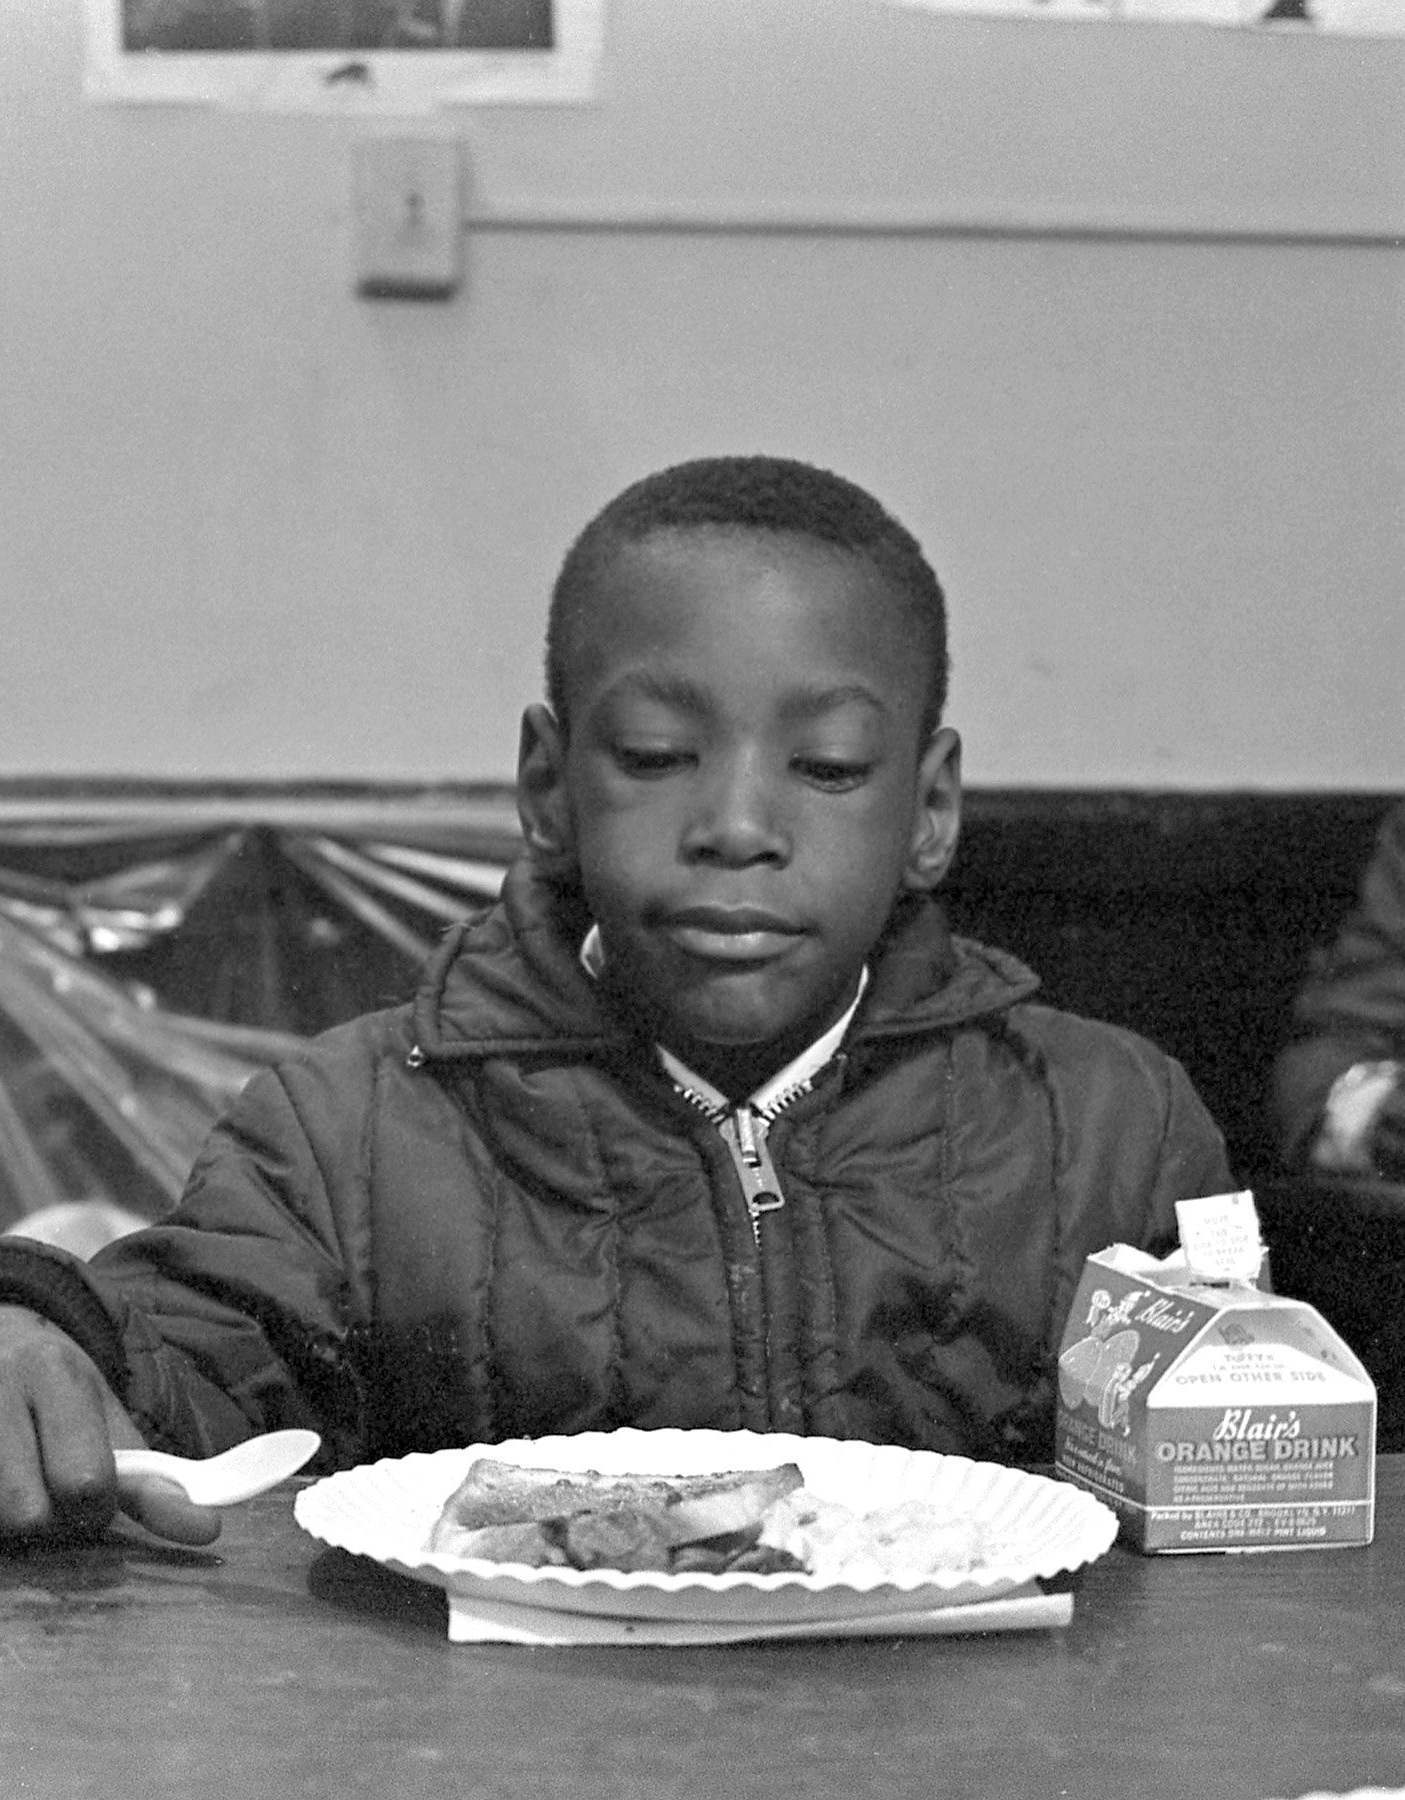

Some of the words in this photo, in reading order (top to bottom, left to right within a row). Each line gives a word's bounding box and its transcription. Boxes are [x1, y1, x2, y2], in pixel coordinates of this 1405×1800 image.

[1174, 1373, 1222, 1385] OPEN
[1229, 1371, 1284, 1383] OTHER
[1290, 1370, 1327, 1383] SIDE
[1212, 1408, 1301, 1440] Blair's
[1155, 1439, 1268, 1462] ORANGE
[1274, 1435, 1358, 1460] DRINK
